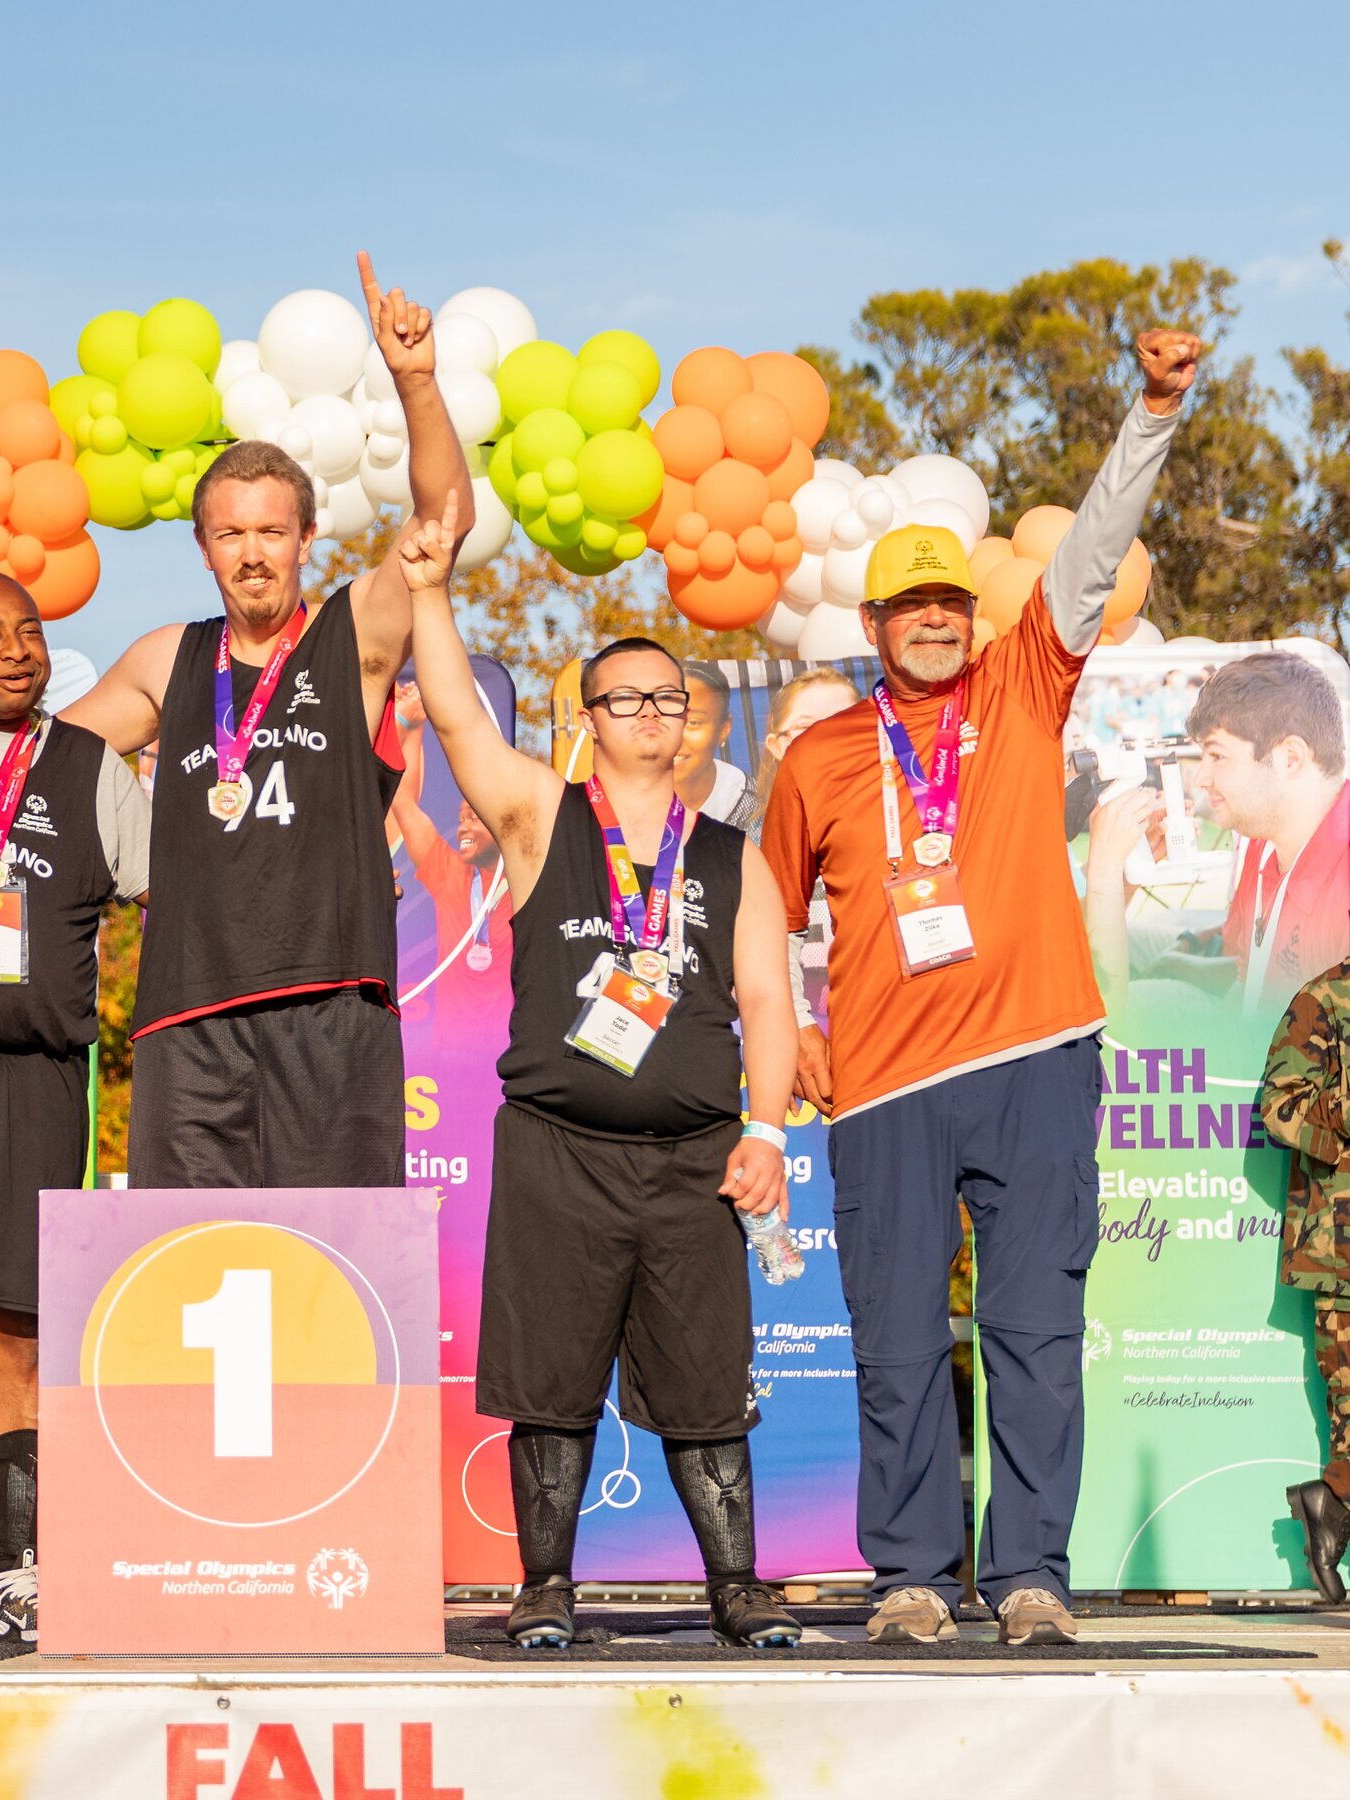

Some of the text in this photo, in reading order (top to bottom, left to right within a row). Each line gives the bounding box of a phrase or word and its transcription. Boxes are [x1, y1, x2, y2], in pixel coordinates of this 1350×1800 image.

[880, 700, 898, 727] GAMES
[250, 723, 327, 752] OLANO
[180, 743, 218, 774] TEA
[224, 760, 295, 832] 94
[21, 812, 51, 822] Special
[617, 858, 630, 880] GOLD
[650, 888, 668, 932] GAMES
[559, 917, 613, 940] TEAM
[928, 953, 952, 965] COACH
[611, 1020, 628, 1033] Todd
[615, 1015, 630, 1026] Jace
[1100, 1048, 1206, 1094] LTH
[1095, 1103, 1290, 1149] ELLNE
[1098, 1168, 1248, 1204] Elevating
[1098, 1198, 1285, 1262] body and mi
[1122, 1328, 1286, 1345] Special Olympics
[757, 1340, 816, 1355] California
[1123, 1345, 1242, 1360] Northern California
[182, 1269, 272, 1458] 1
[757, 1368, 772, 1379] for
[803, 1368, 840, 1378] inclusive
[439, 1375, 477, 1383] omorrow
[1123, 1375, 1155, 1385] Playing
[1157, 1375, 1181, 1385] today
[1182, 1375, 1197, 1385] for
[1228, 1375, 1266, 1384] inclusive
[1267, 1375, 1309, 1384] tomorrow
[1123, 1391, 1255, 1409] #CelebrateInclusion
[112, 1560, 297, 1579] Special Olympics
[162, 1580, 295, 1596] Northern California
[166, 1722, 464, 1800] FALL
